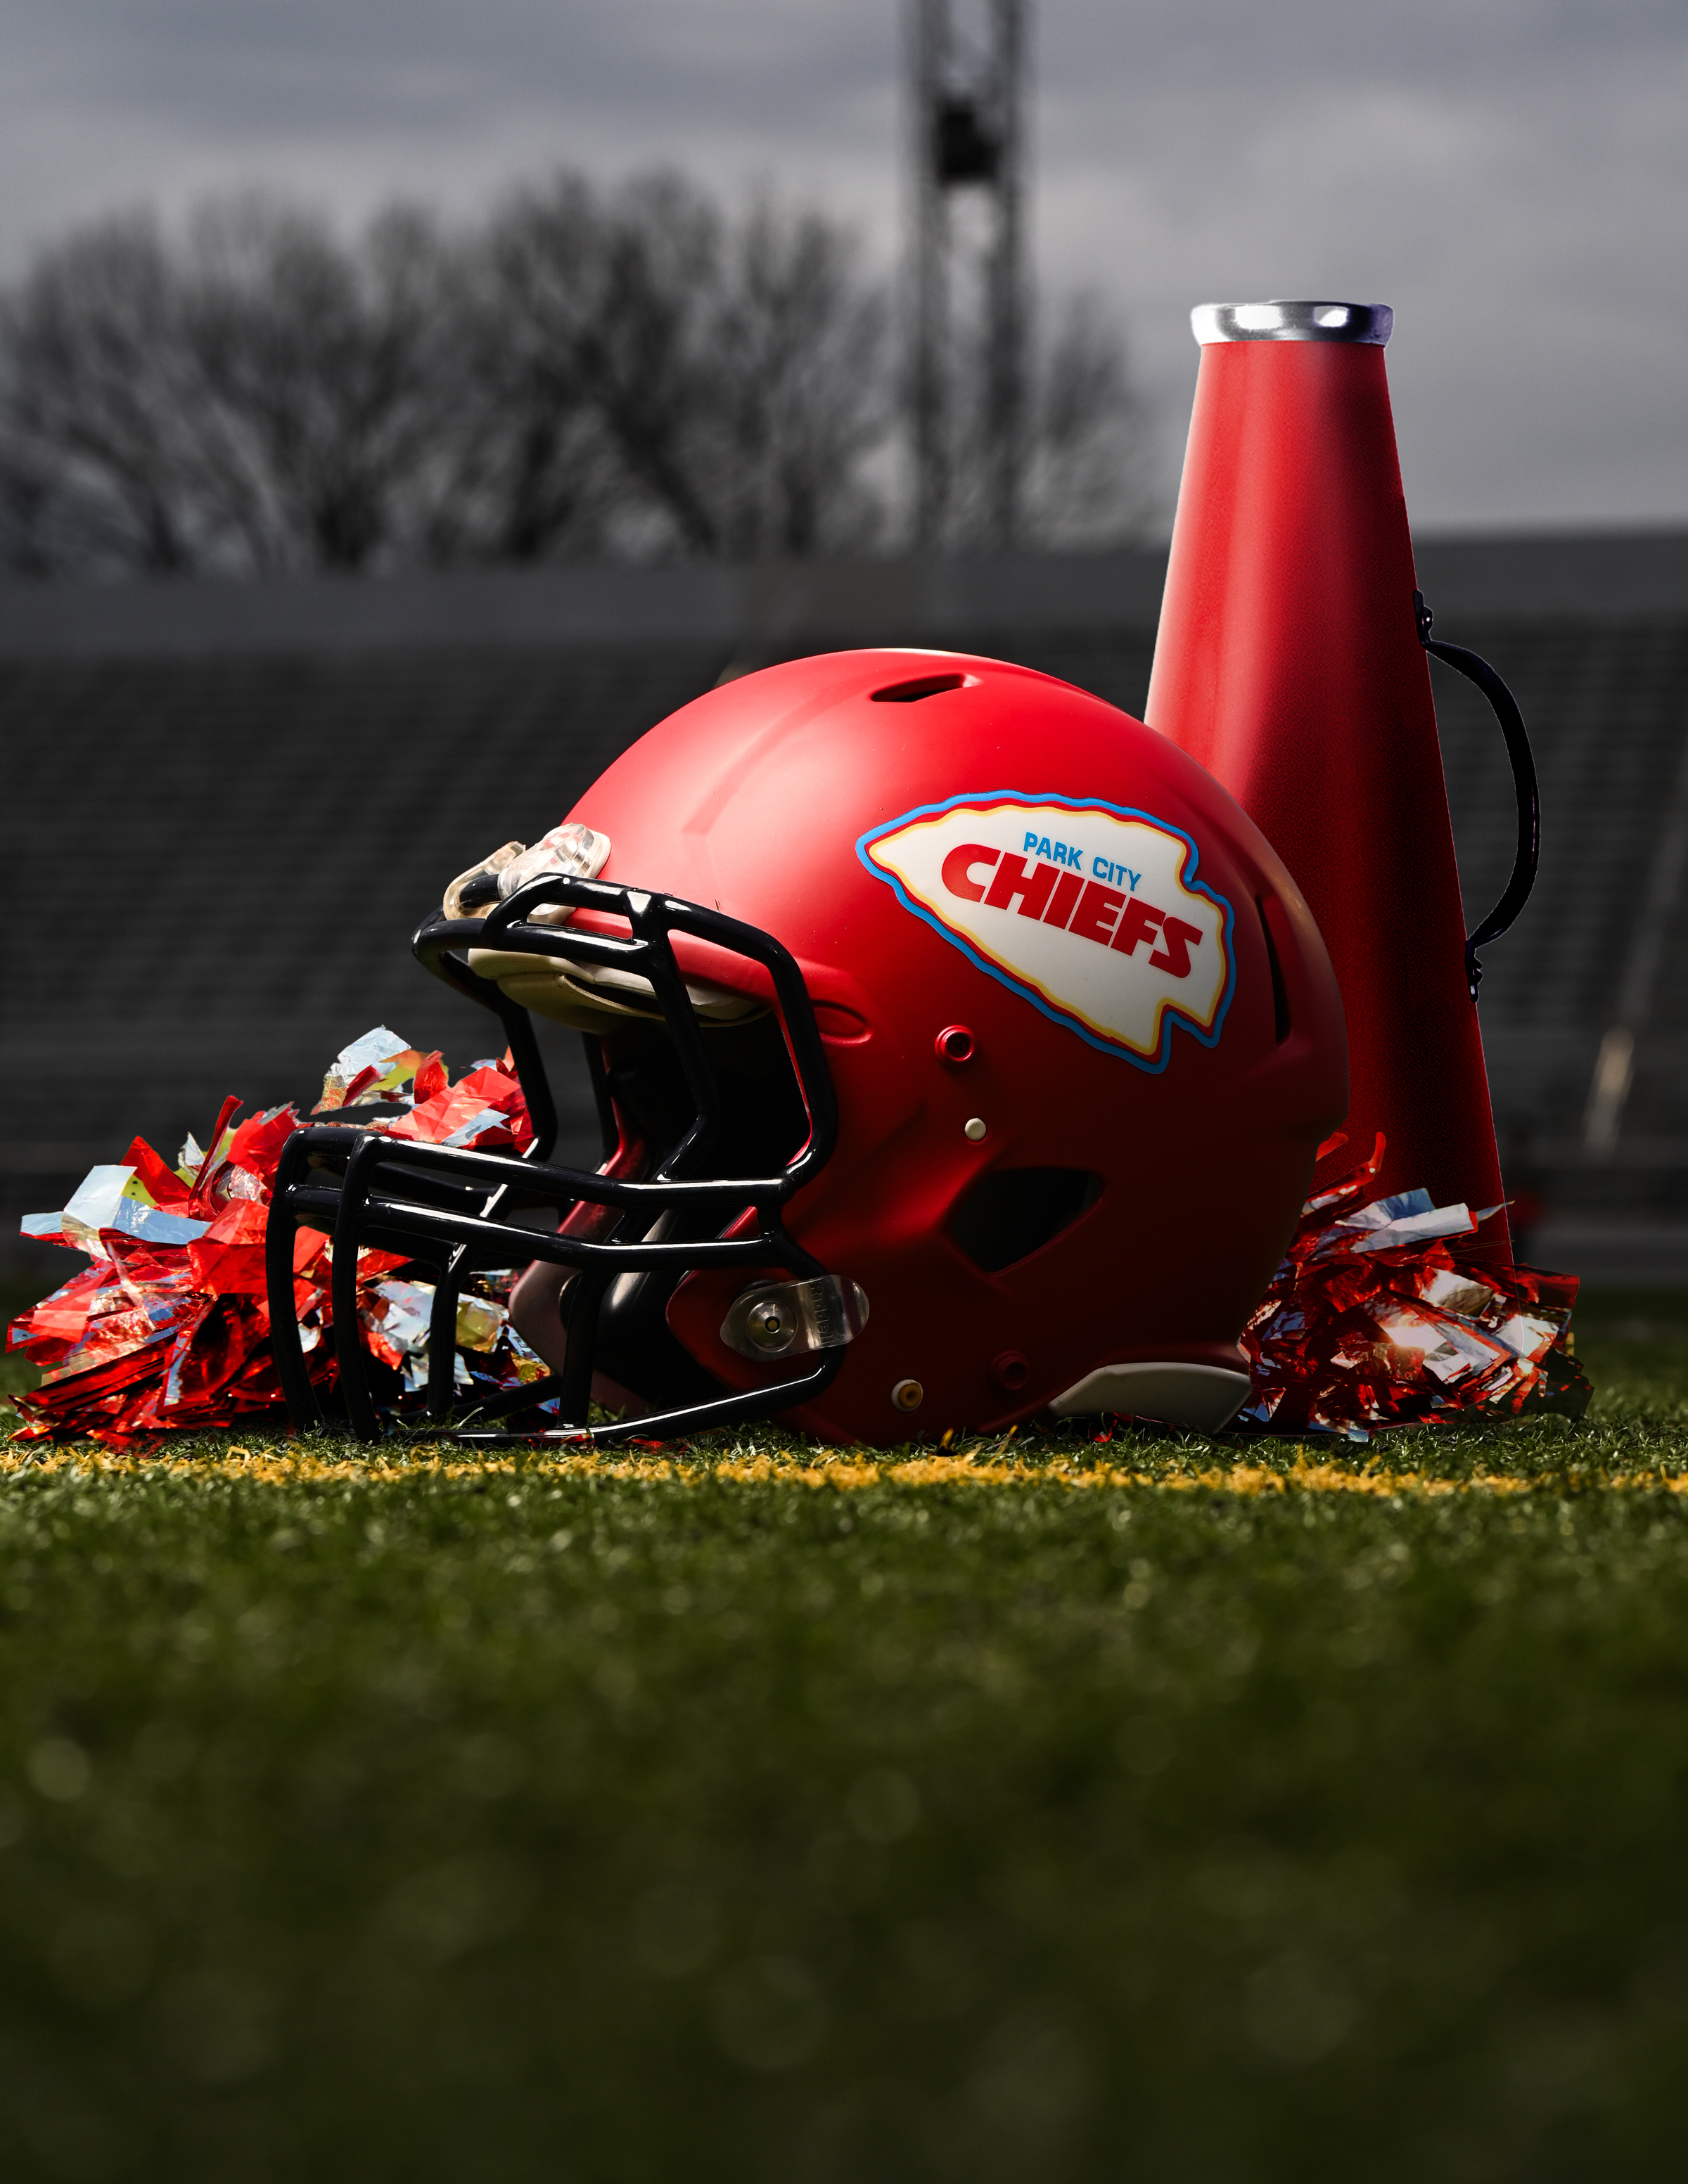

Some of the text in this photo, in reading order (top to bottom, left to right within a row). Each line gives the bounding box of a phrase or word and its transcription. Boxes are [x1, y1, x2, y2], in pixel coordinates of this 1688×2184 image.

[1023, 830, 1142, 892] PARK CITY
[940, 843, 1204, 979] CHIEFS
